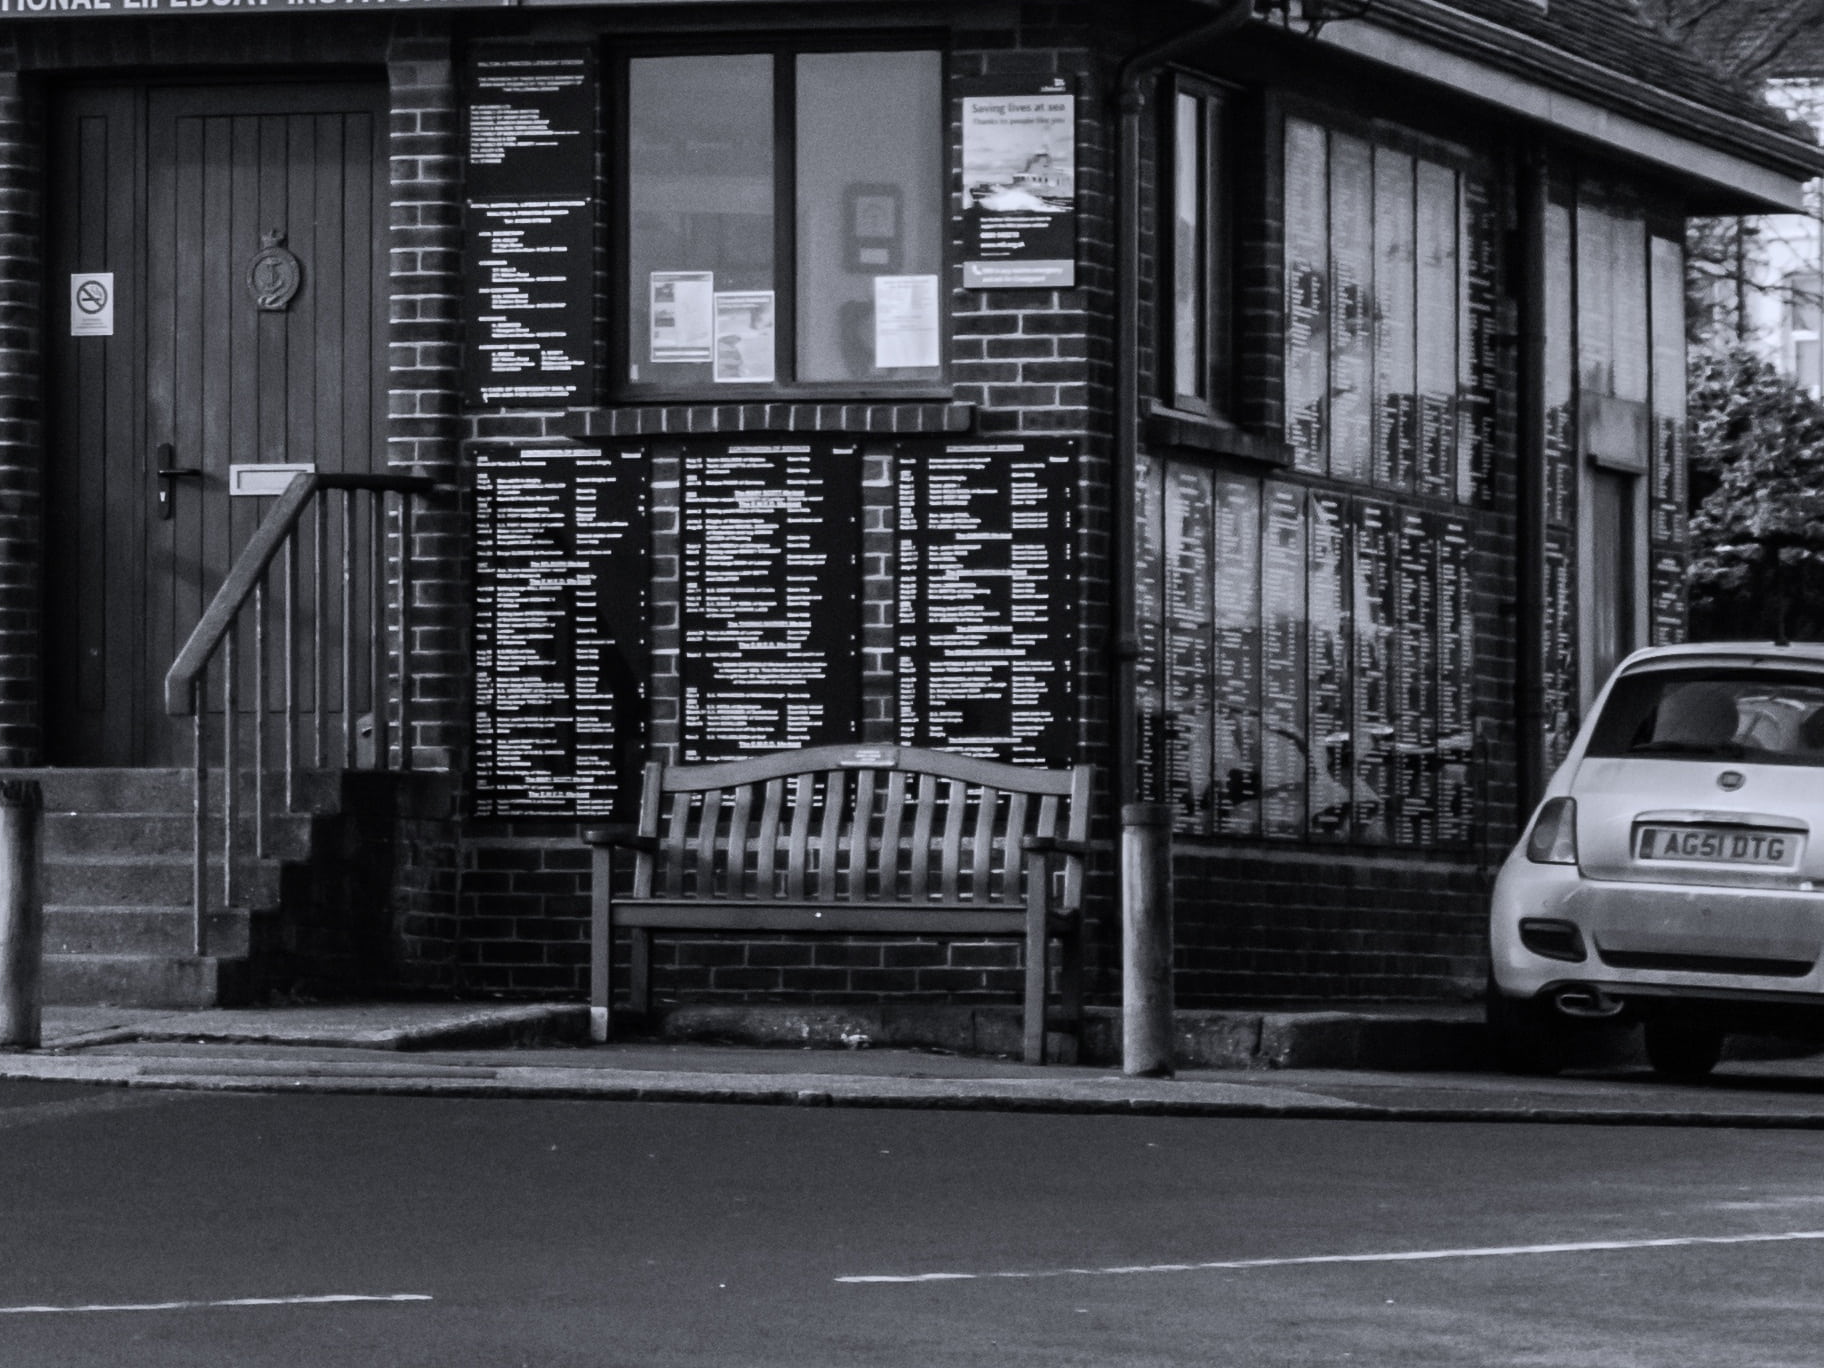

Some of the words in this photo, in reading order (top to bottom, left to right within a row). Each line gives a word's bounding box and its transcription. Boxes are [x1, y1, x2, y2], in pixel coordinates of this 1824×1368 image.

[972, 103, 1005, 115] Saving
[1008, 102, 1031, 112] lives
[1034, 103, 1045, 112] at
[1048, 104, 1065, 112] sea
[1664, 833, 1724, 857] AG51
[1731, 835, 1784, 861] DTG
